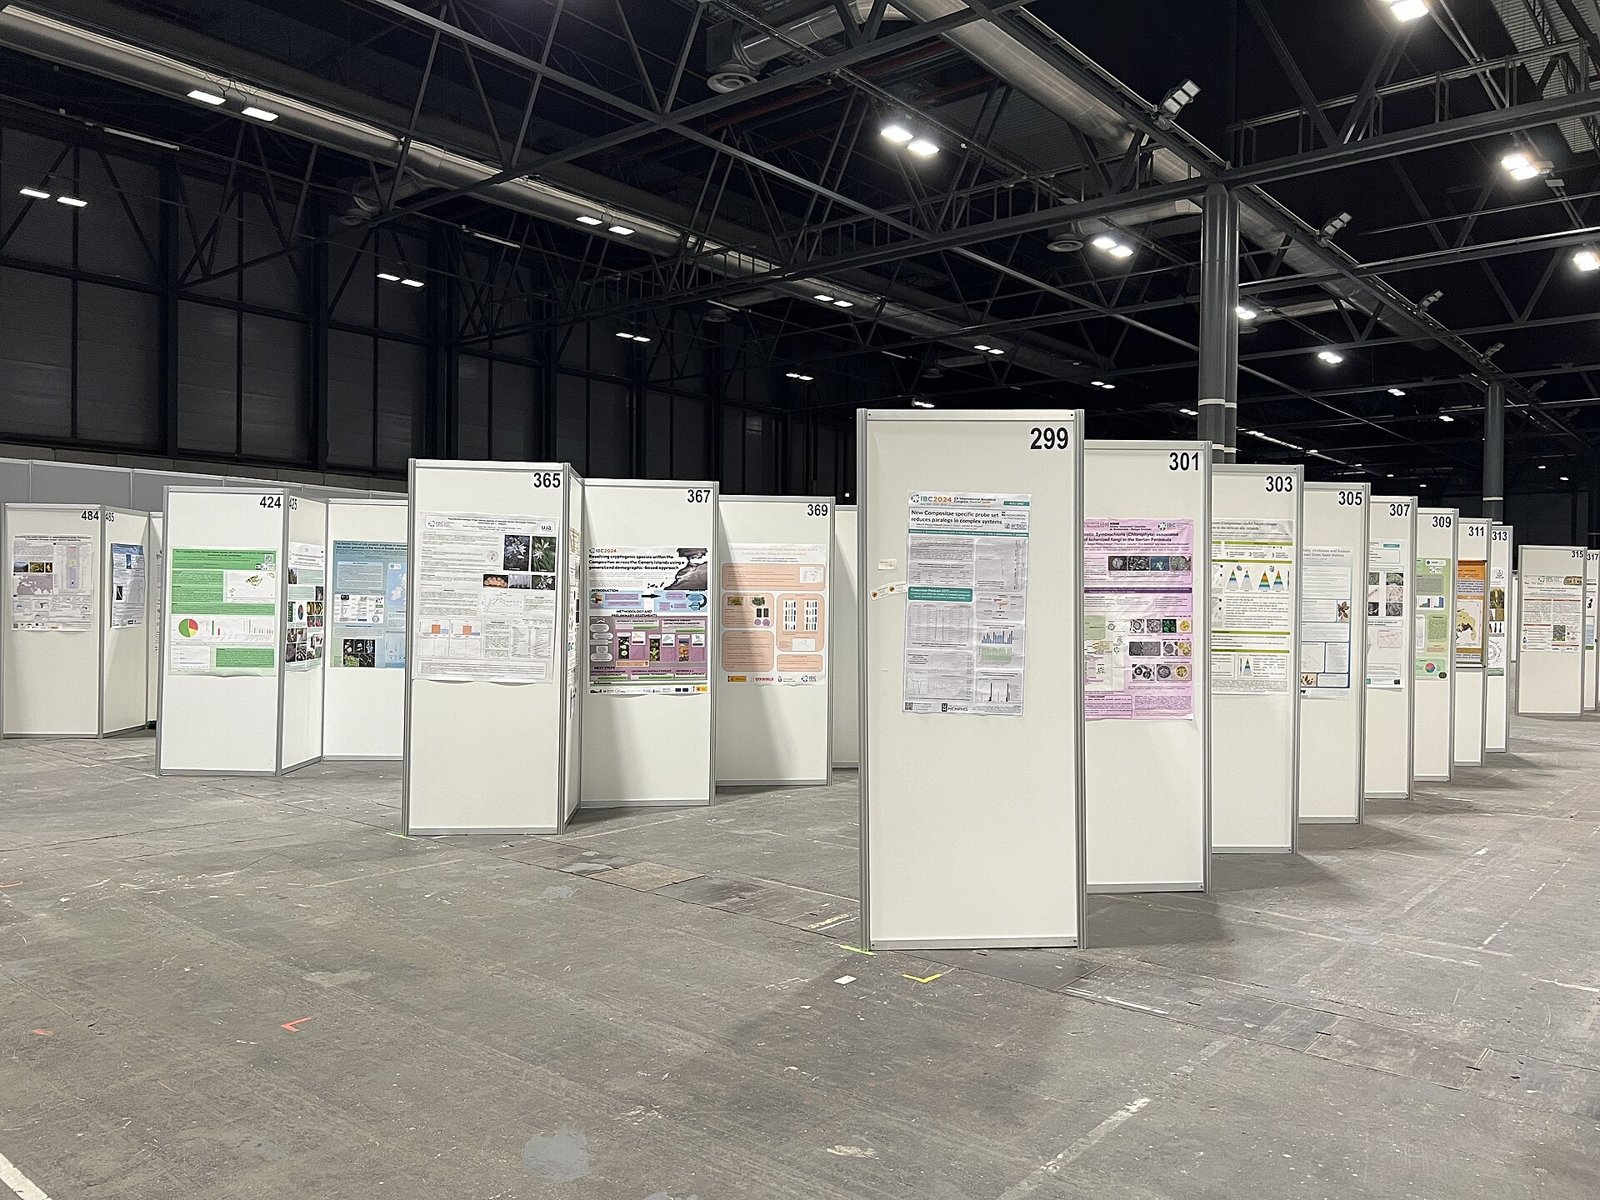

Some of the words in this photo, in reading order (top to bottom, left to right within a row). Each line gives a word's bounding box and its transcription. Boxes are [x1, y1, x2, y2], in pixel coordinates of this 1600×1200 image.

[1030, 427, 1069, 450] 299
[1169, 452, 1199, 471] 301
[533, 473, 561, 488] 365
[1265, 476, 1293, 492] 303
[259, 496, 282, 509] 424
[687, 489, 711, 503] 367
[920, 495, 952, 503] IBC2024
[1338, 491, 1363, 505] 305
[81, 510, 100, 521] 484
[807, 504, 829, 517] 369
[1389, 503, 1411, 517] 307
[1432, 516, 1452, 528] 309
[1468, 526, 1484, 537] 311
[1492, 531, 1508, 541] 313
[1571, 550, 1584, 558] 315
[1586, 553, 1599, 561] 317
